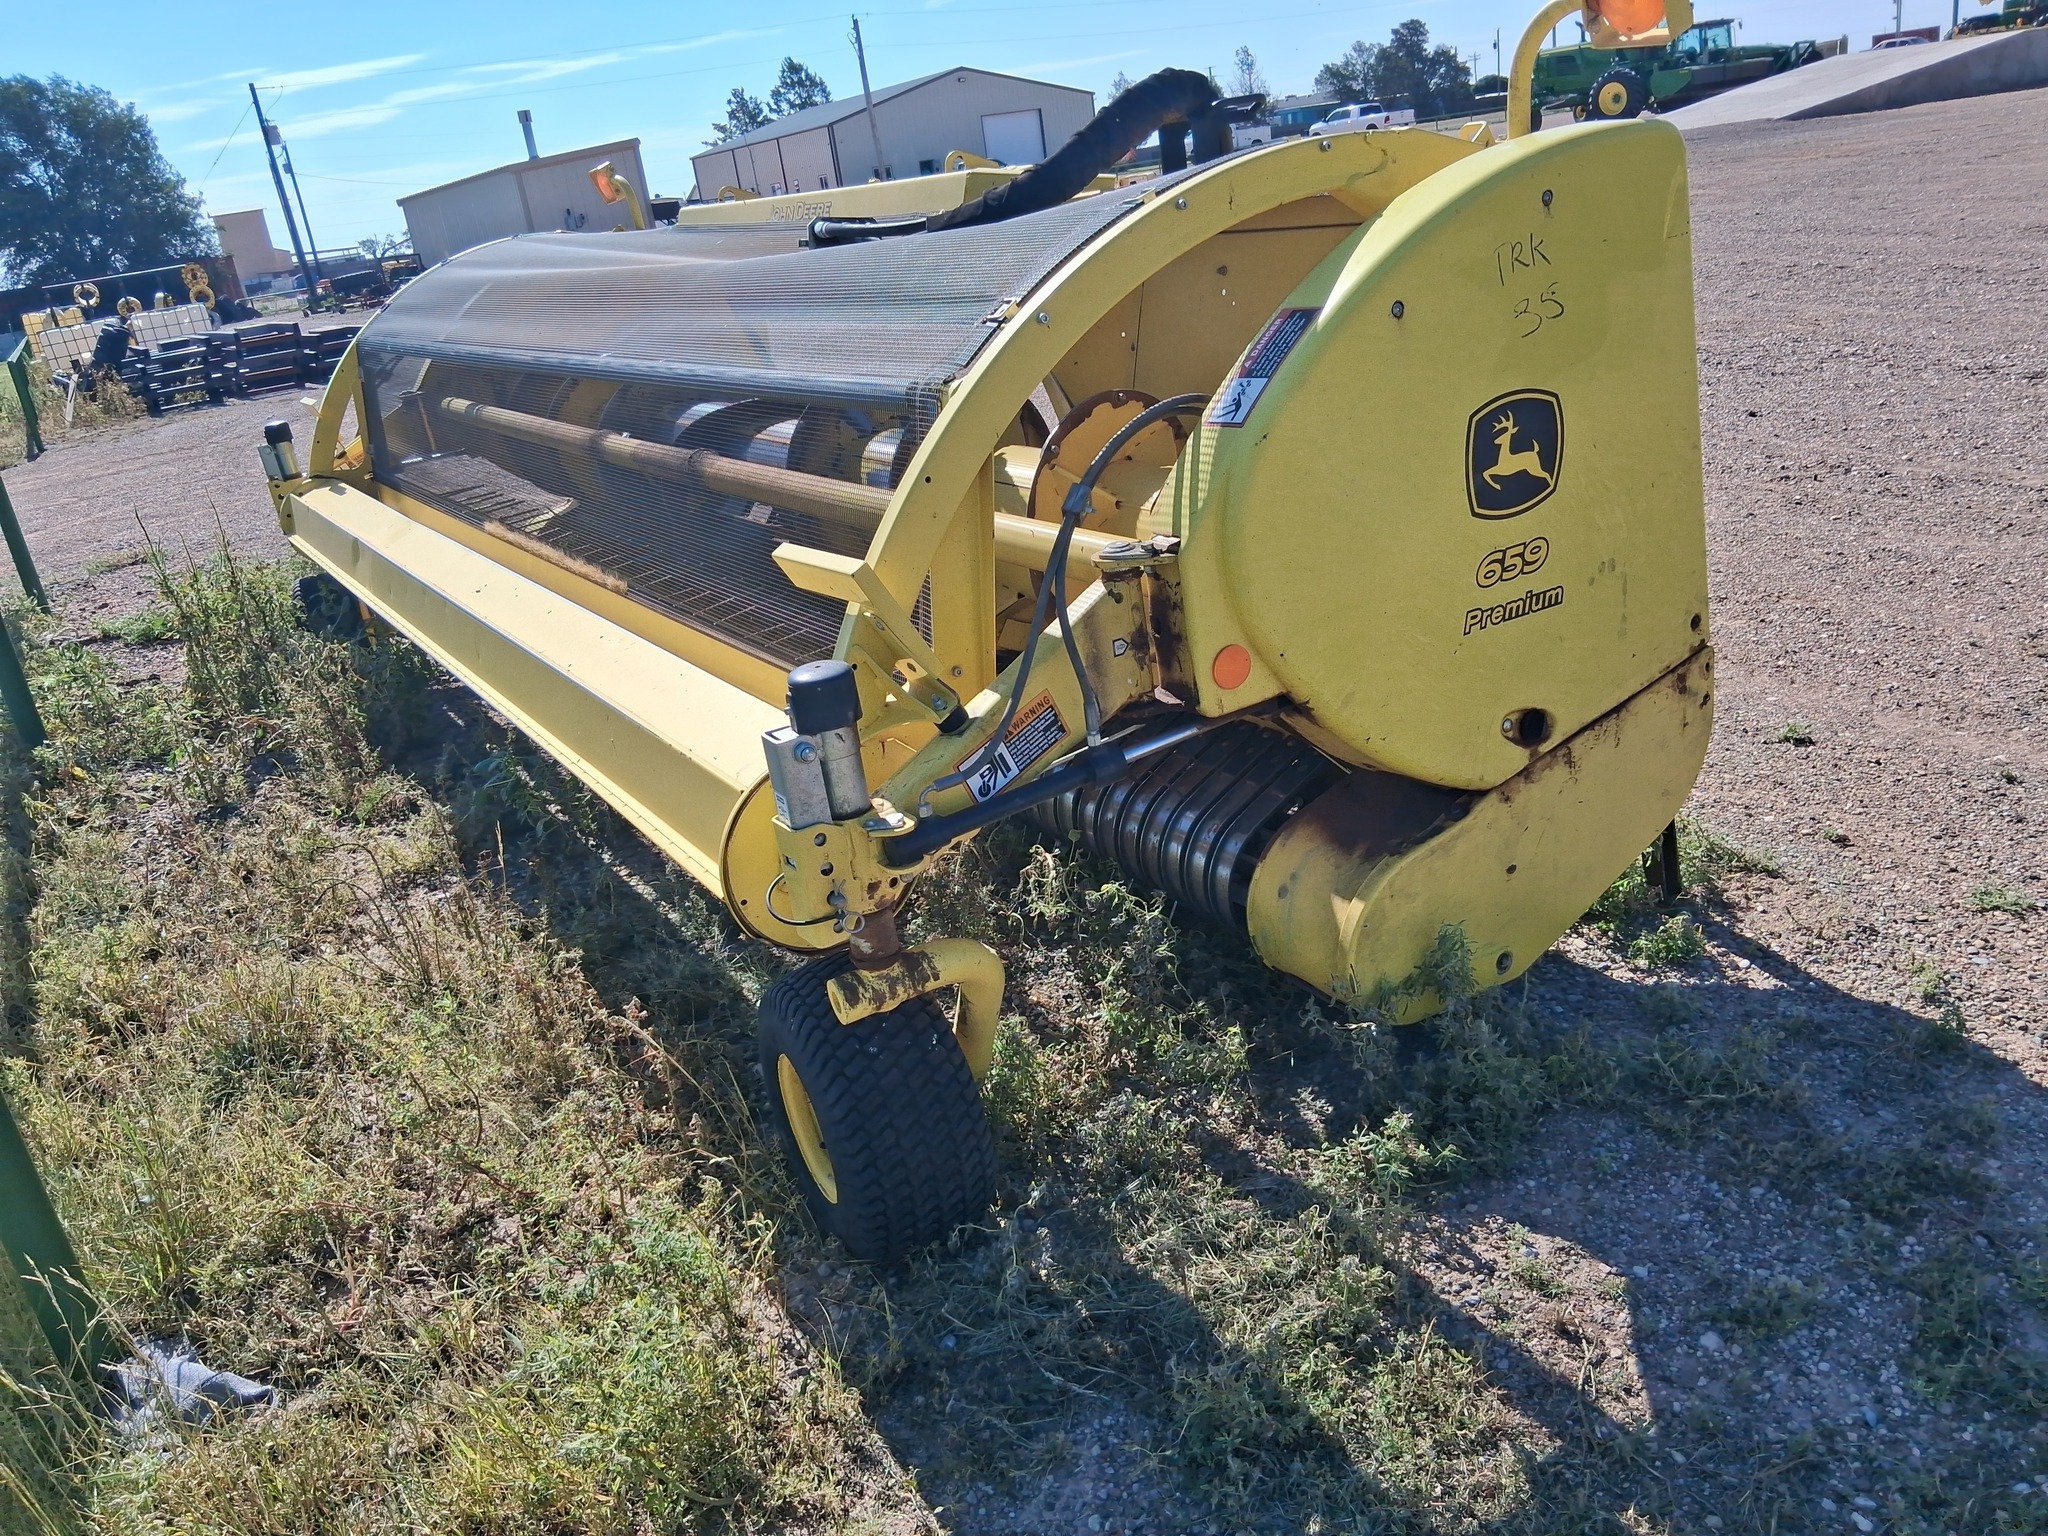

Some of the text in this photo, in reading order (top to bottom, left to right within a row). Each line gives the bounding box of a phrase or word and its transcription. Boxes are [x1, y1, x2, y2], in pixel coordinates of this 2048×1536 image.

[796, 200, 832, 219] DEERE
[1493, 233, 1551, 286] TRK
[1251, 318, 1283, 357] DANGER
[1476, 536, 1549, 588] 659
[1463, 585, 1564, 636] Premium
[1011, 695, 1050, 731] WARNING
